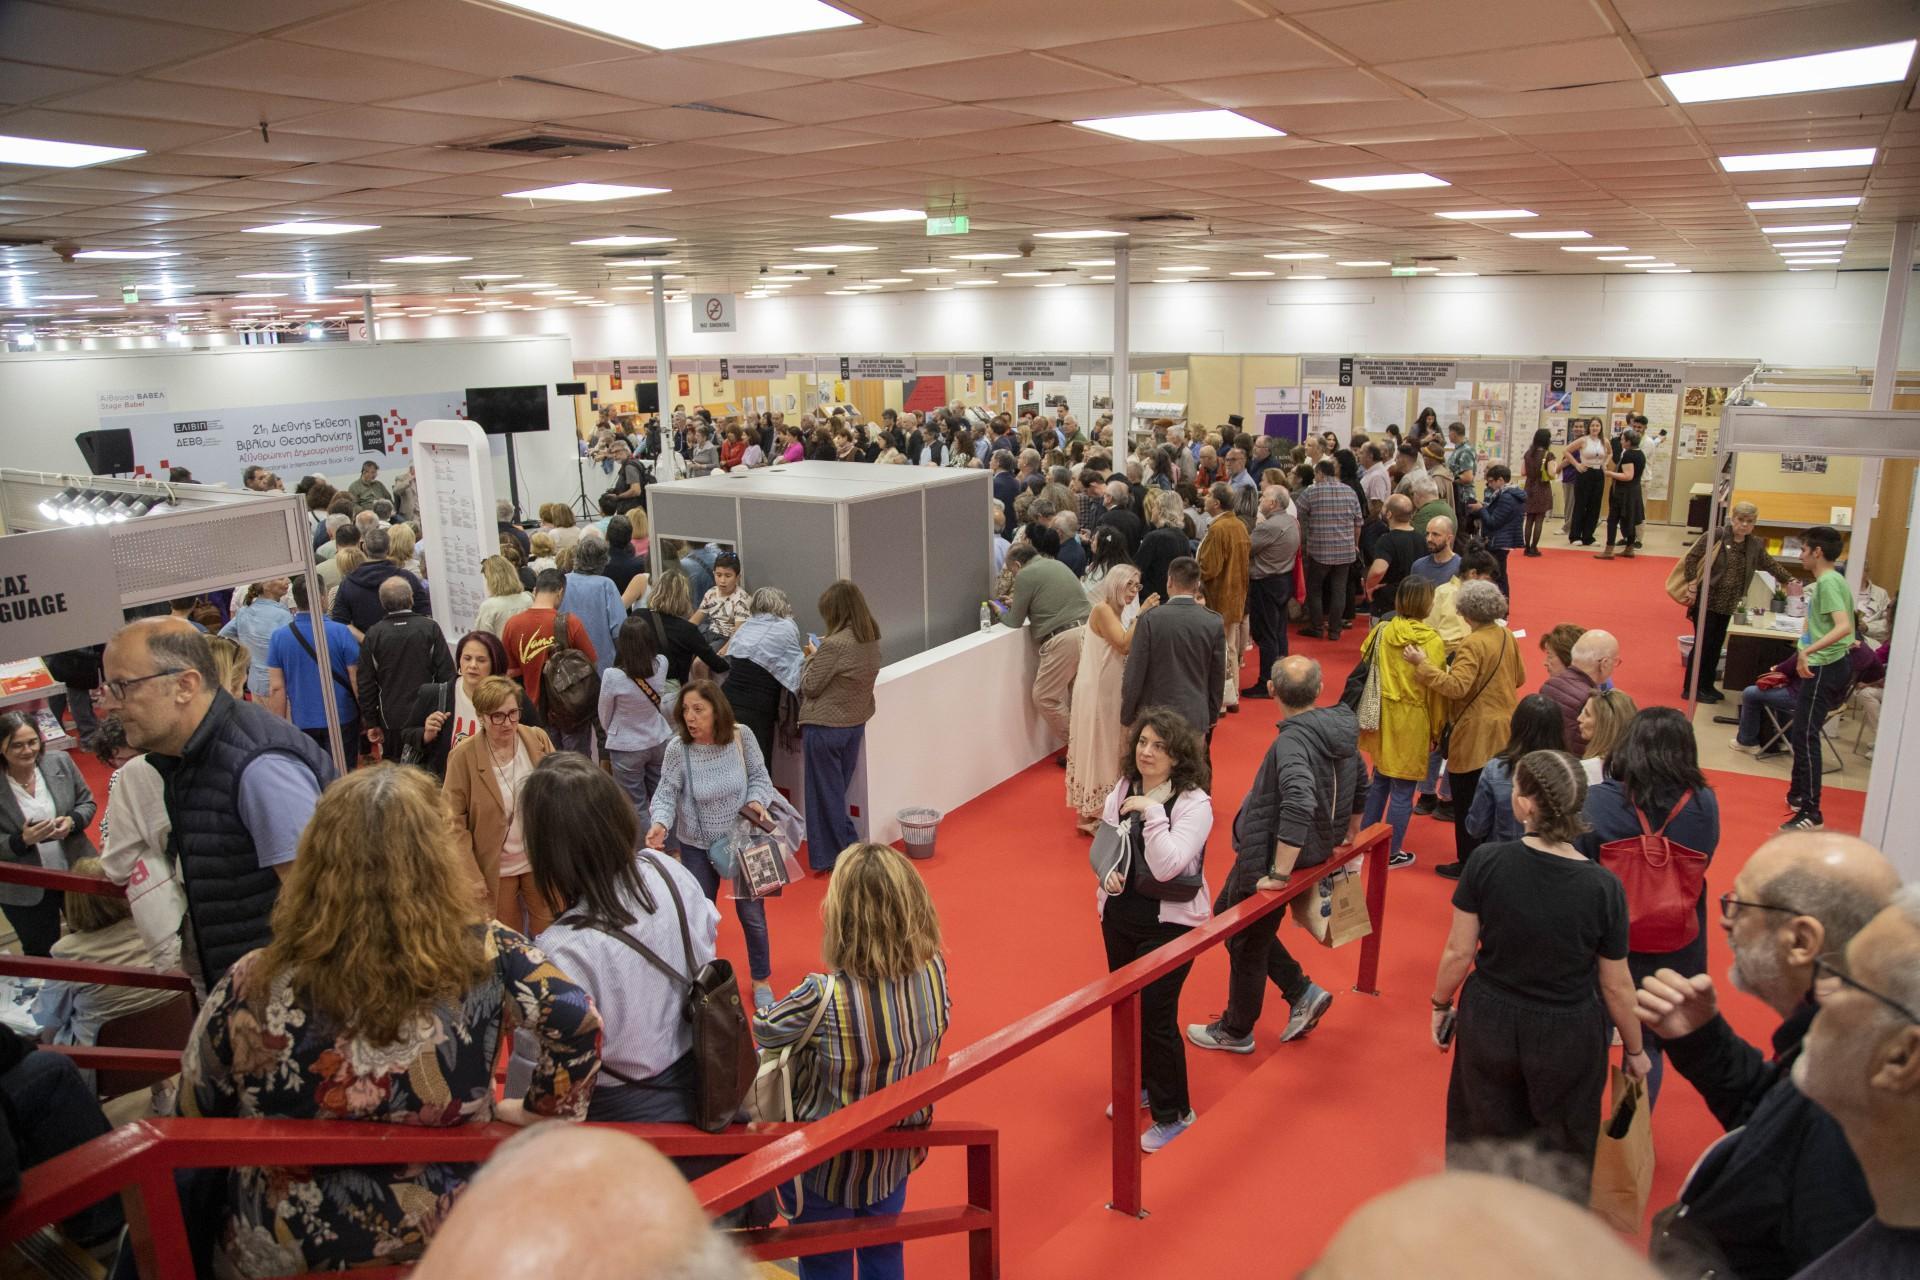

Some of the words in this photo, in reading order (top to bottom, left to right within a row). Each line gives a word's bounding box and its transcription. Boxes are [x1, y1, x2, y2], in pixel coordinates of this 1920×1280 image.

[136, 392, 166, 400] ΒΑΒΕΛ
[175, 422, 207, 432] ΕΛΙΒΙΠ
[272, 420, 312, 434] Διεθνής
[176, 436, 203, 447] ΔΕΒΘ
[236, 438, 276, 452] Βιβλίου
[280, 431, 352, 446] Θεσσαλονίκης
